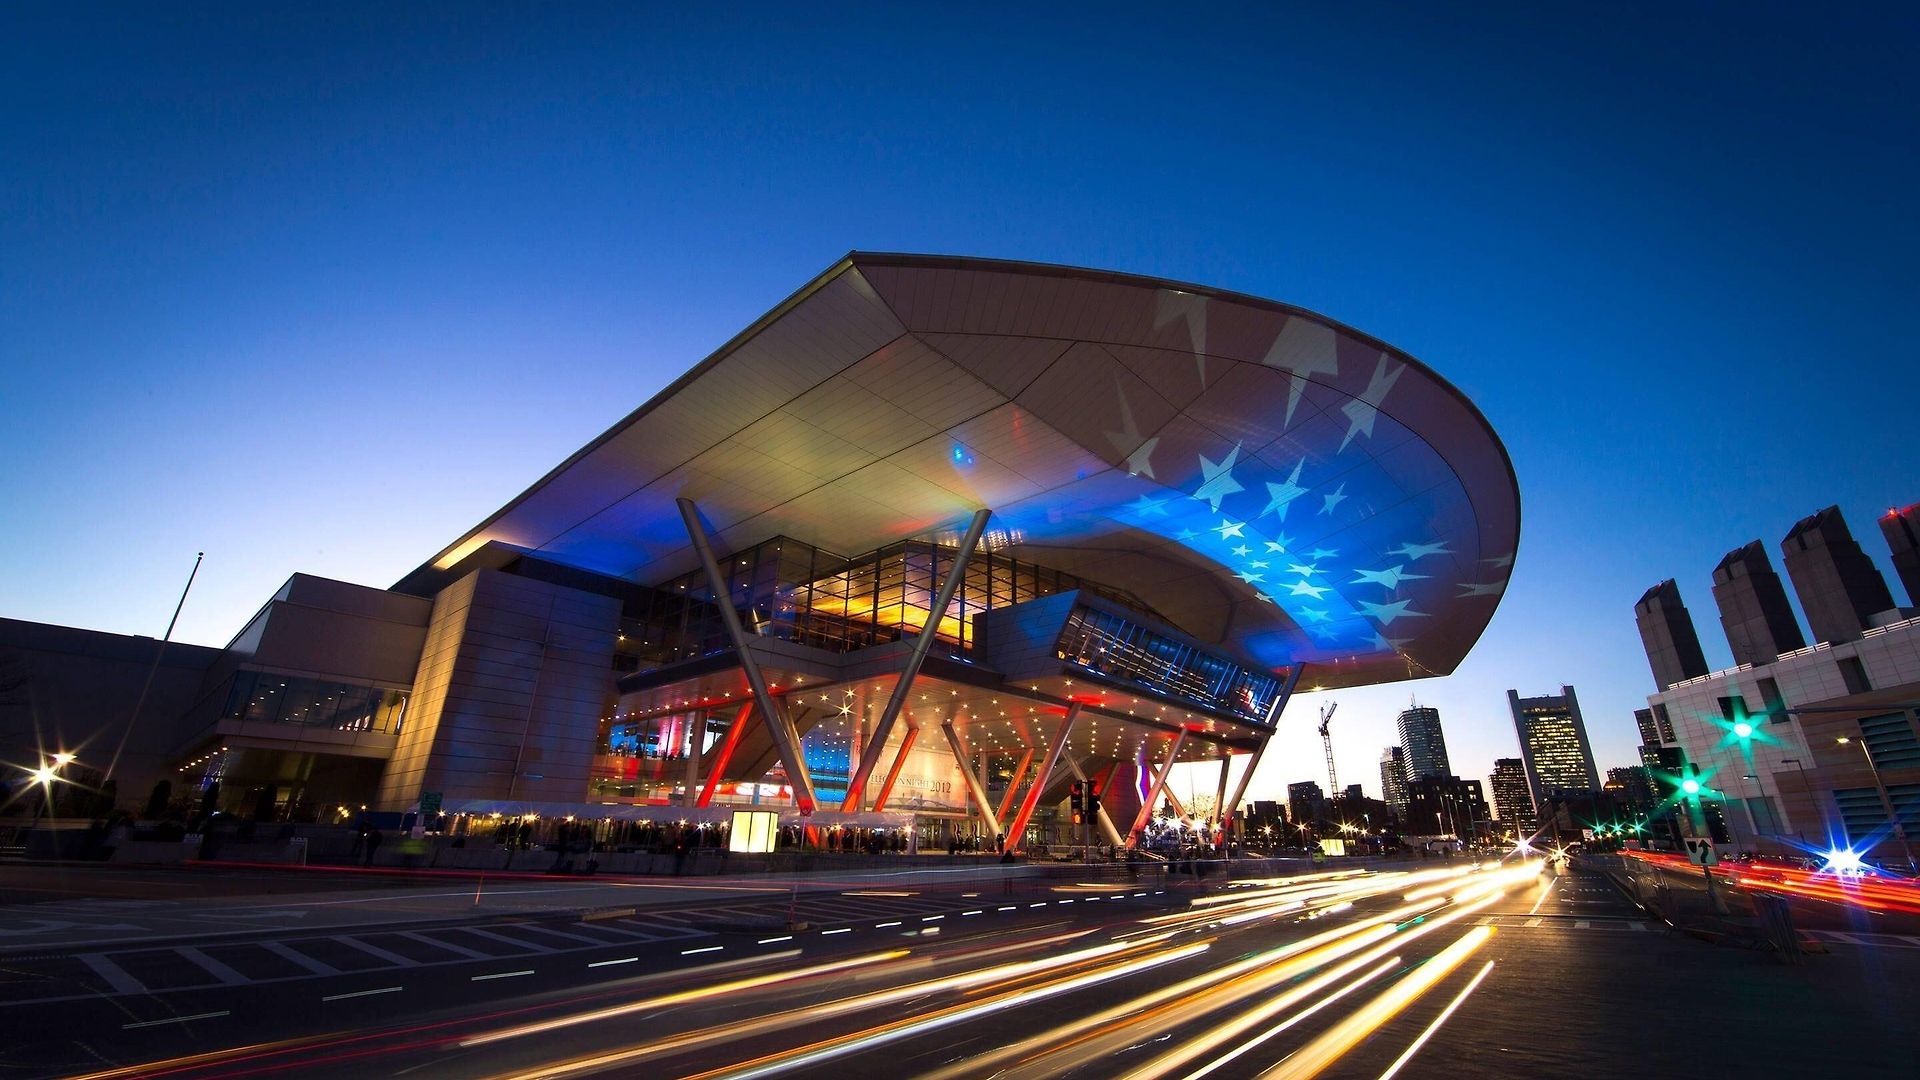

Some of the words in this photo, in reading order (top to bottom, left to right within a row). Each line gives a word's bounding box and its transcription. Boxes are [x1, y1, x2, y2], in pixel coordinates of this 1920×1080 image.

[871, 774, 905, 785] ELECON
[906, 777, 929, 788] NIGHT
[930, 780, 951, 793] 2012
